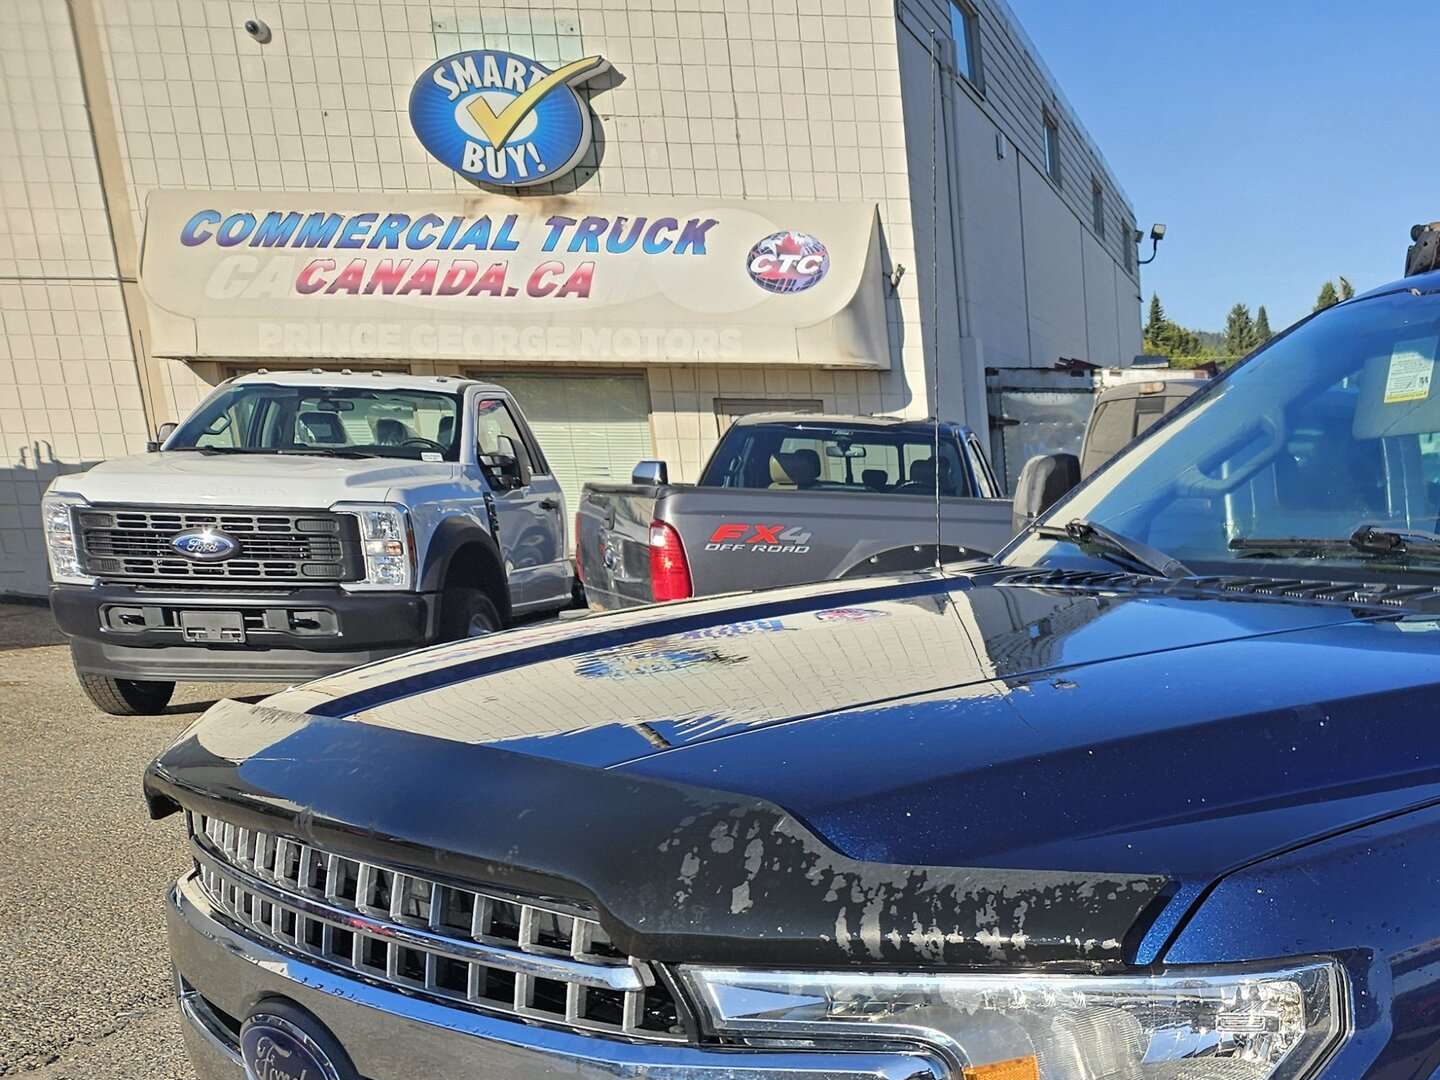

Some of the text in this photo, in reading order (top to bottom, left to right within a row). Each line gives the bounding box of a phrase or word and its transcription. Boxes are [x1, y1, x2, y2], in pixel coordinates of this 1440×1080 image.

[433, 55, 551, 101] SMART
[462, 140, 546, 179] BUY!
[180, 209, 720, 255] COMMERCIAL TRUCK
[295, 257, 596, 298] CANADA.CA
[750, 254, 823, 274] CTC
[258, 321, 743, 358] PRINCE GEORGE MOTORS
[704, 543, 810, 554] OFF ROAD
[709, 523, 812, 545] FX4
